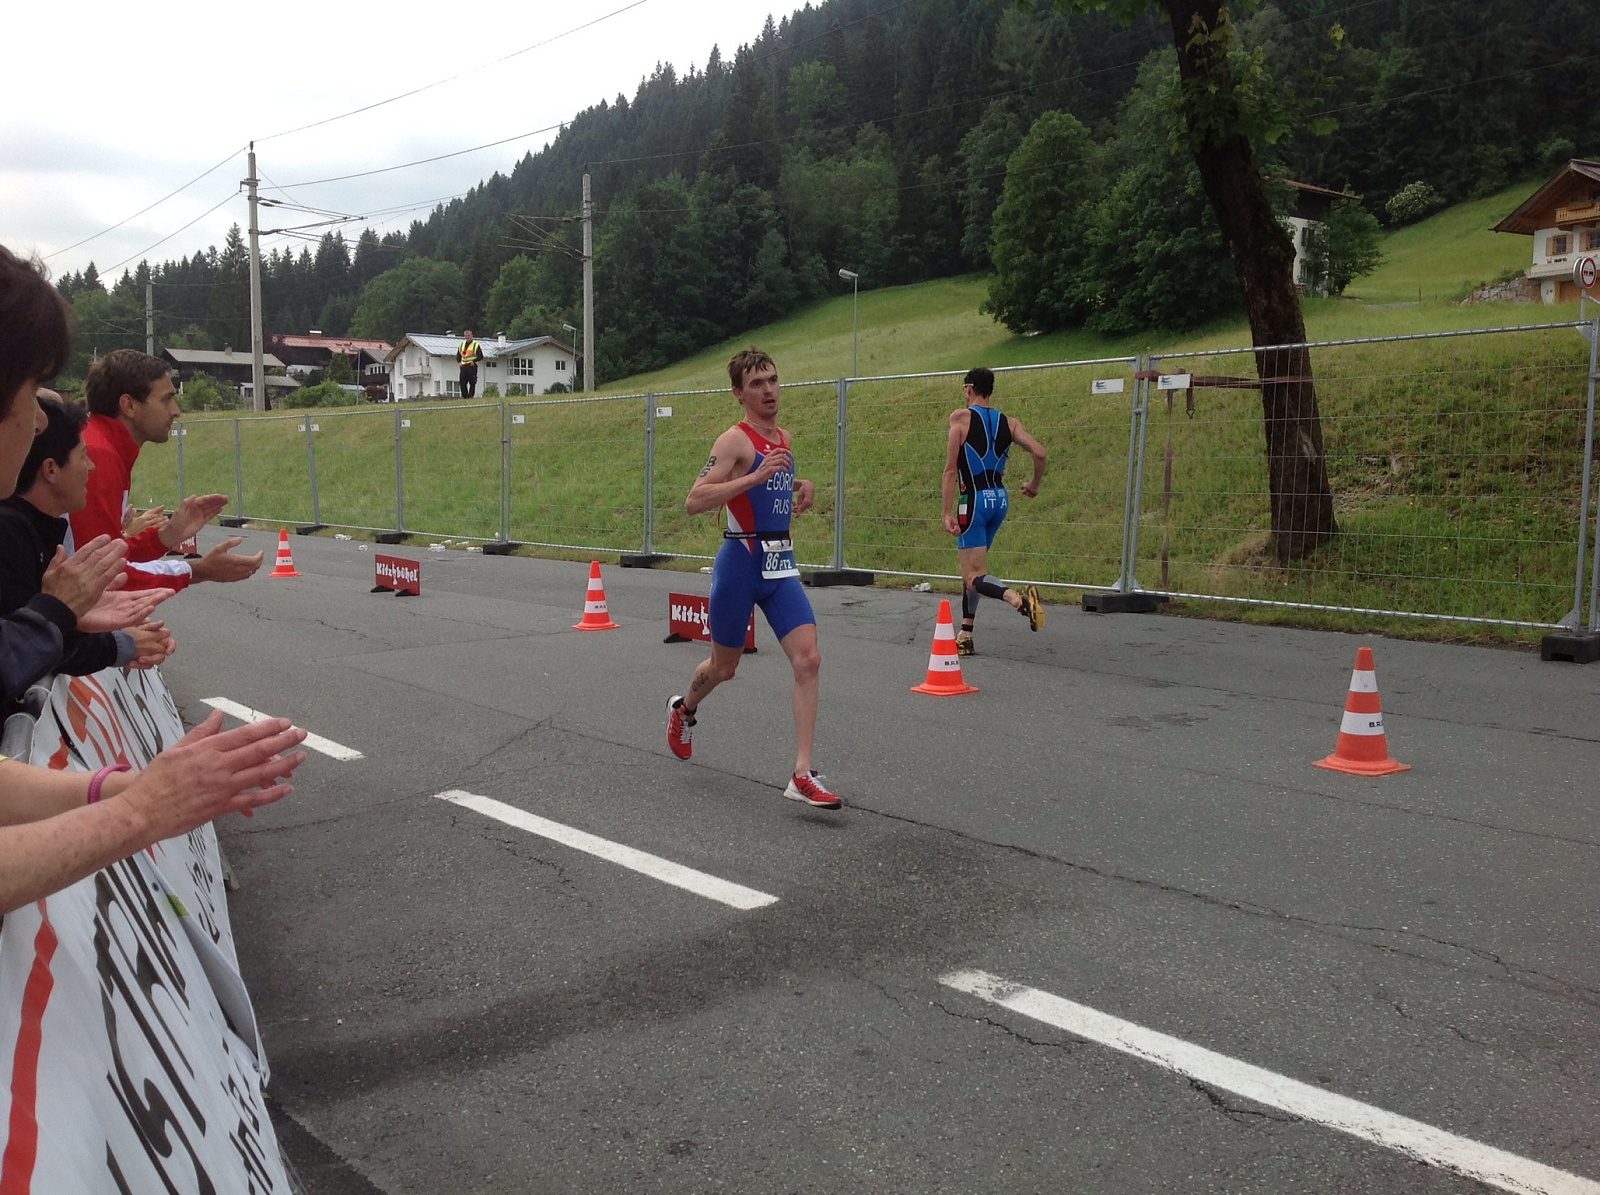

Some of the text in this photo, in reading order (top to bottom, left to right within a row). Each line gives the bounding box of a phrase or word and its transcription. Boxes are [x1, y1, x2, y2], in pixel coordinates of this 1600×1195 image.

[772, 498, 790, 515] RUS
[984, 498, 1007, 509] ITA
[765, 552, 780, 571] 86
